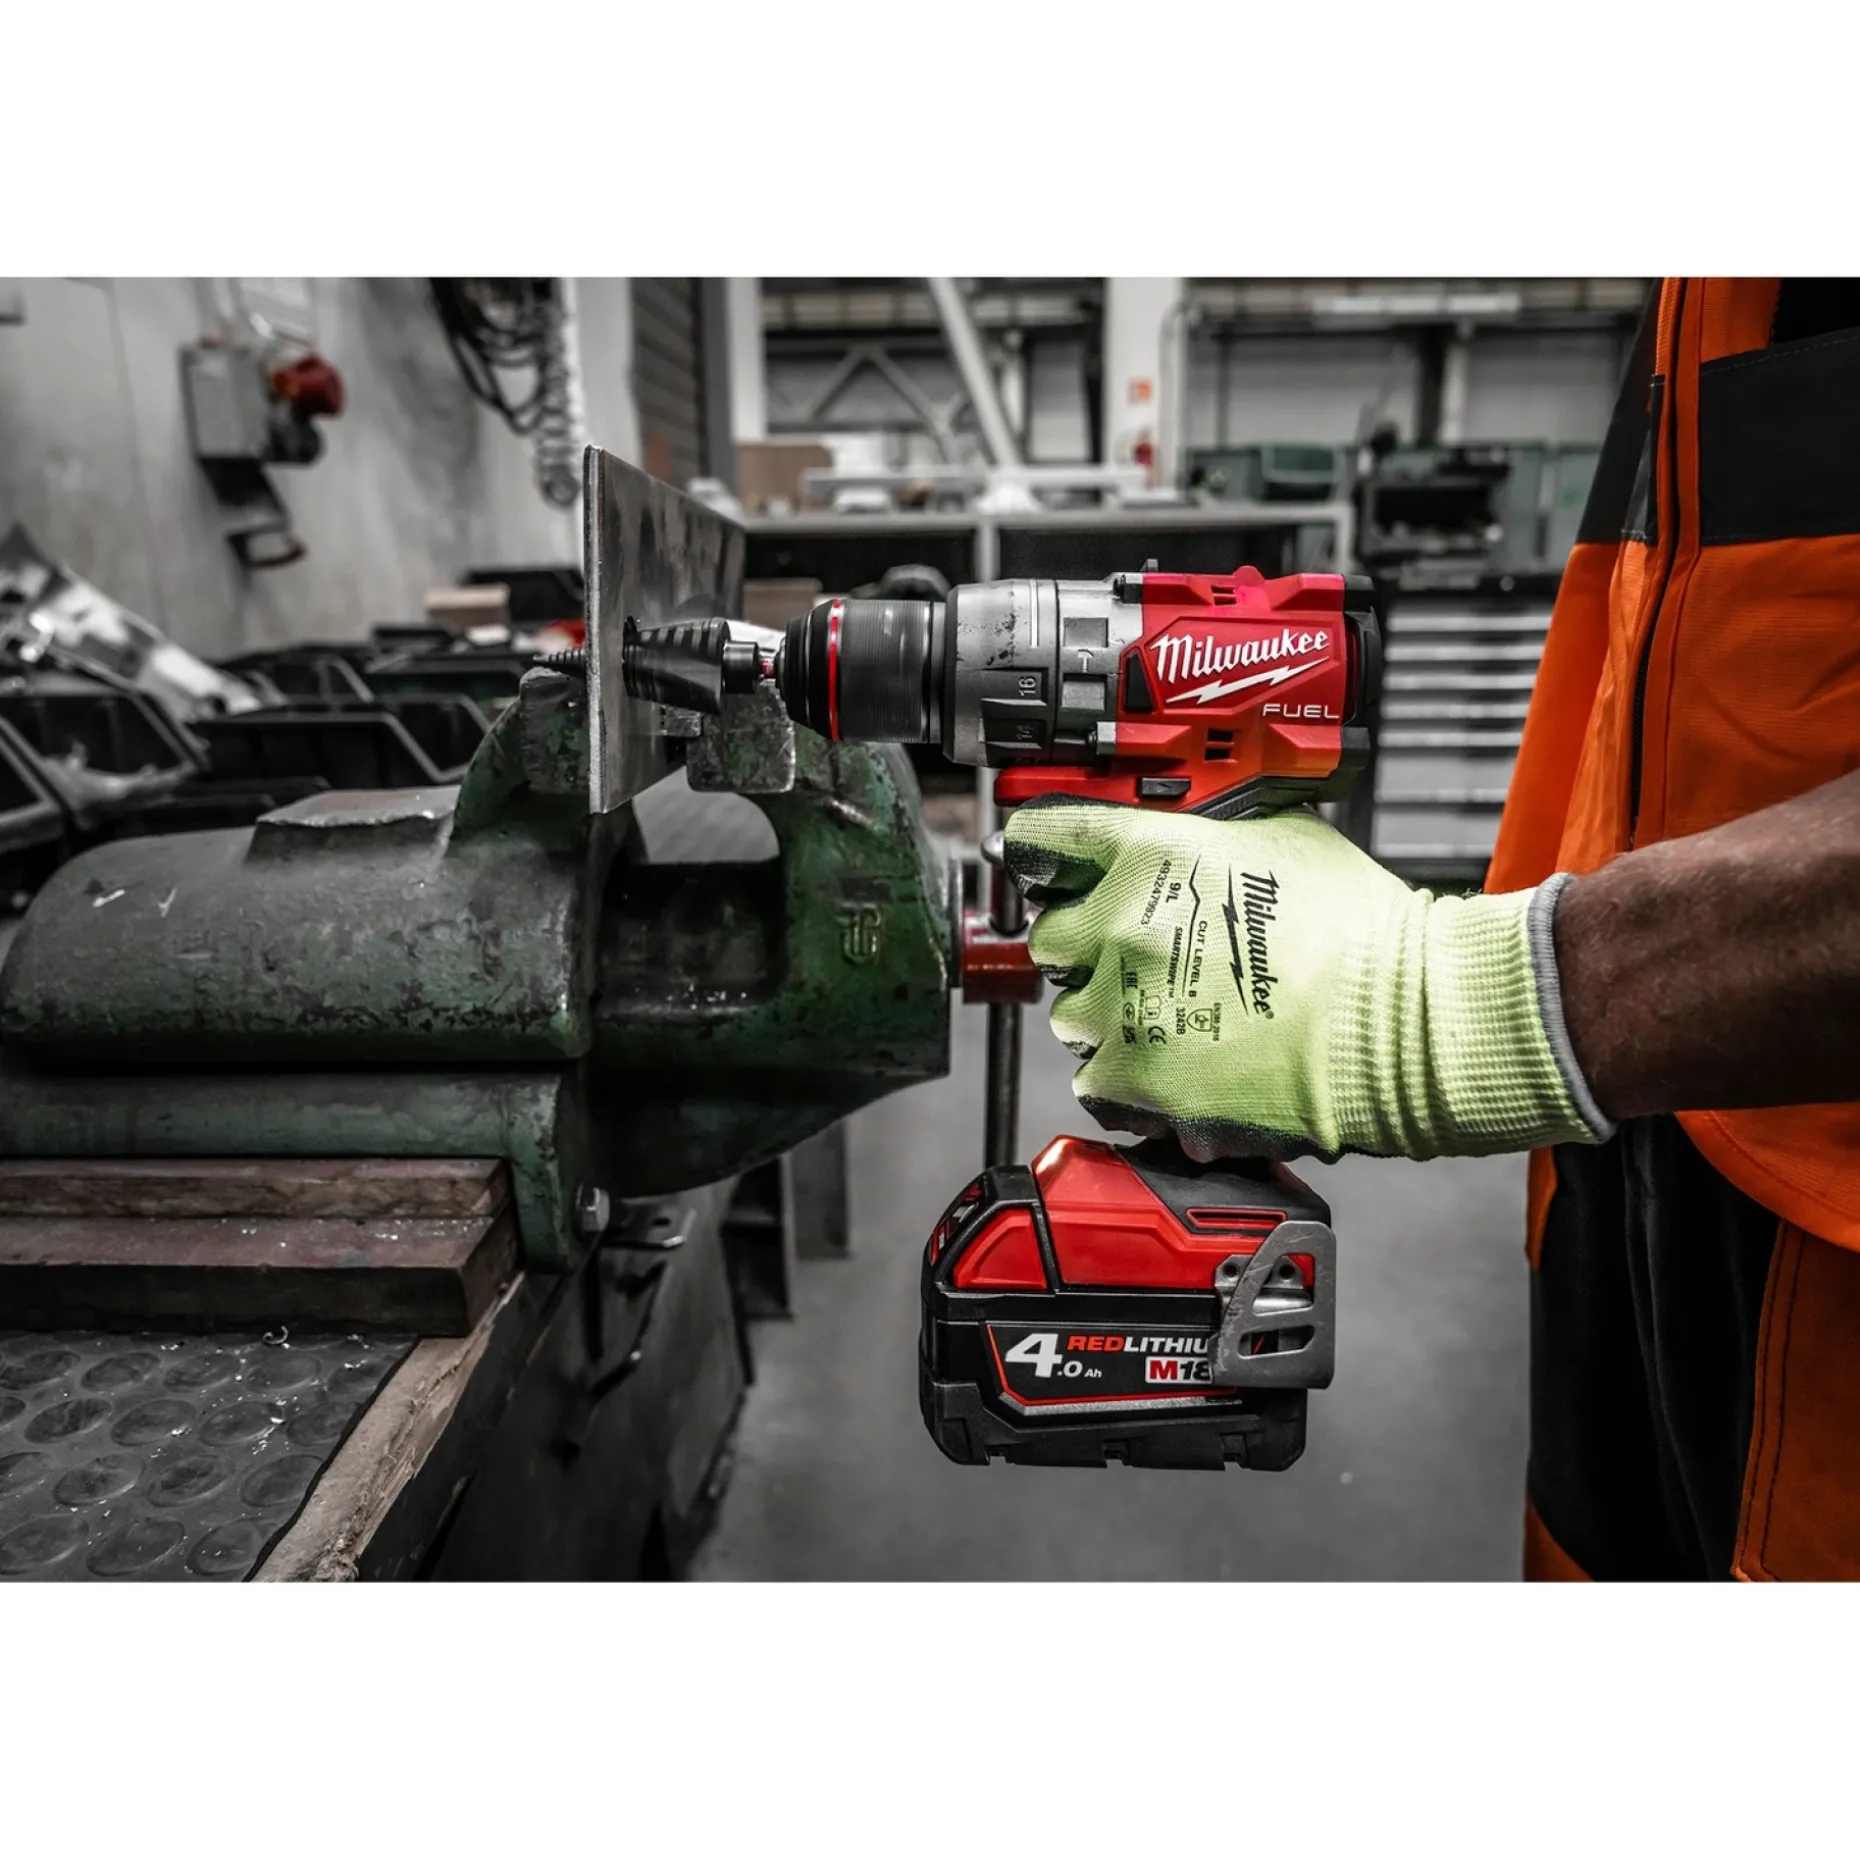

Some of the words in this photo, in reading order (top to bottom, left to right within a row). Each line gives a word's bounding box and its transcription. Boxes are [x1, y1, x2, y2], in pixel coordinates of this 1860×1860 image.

[1150, 628, 1331, 684] Milwaukee
[1018, 677, 1037, 696] 16
[1262, 704, 1341, 719] FUEL
[1165, 882, 1182, 903] 9/L
[1196, 920, 1208, 945] CUT
[1189, 948, 1203, 987] LEVEL
[1067, 1335, 1209, 1353] REDLITHIU
[1084, 1368, 1102, 1378] Ah
[1149, 1360, 1211, 1381] M18
